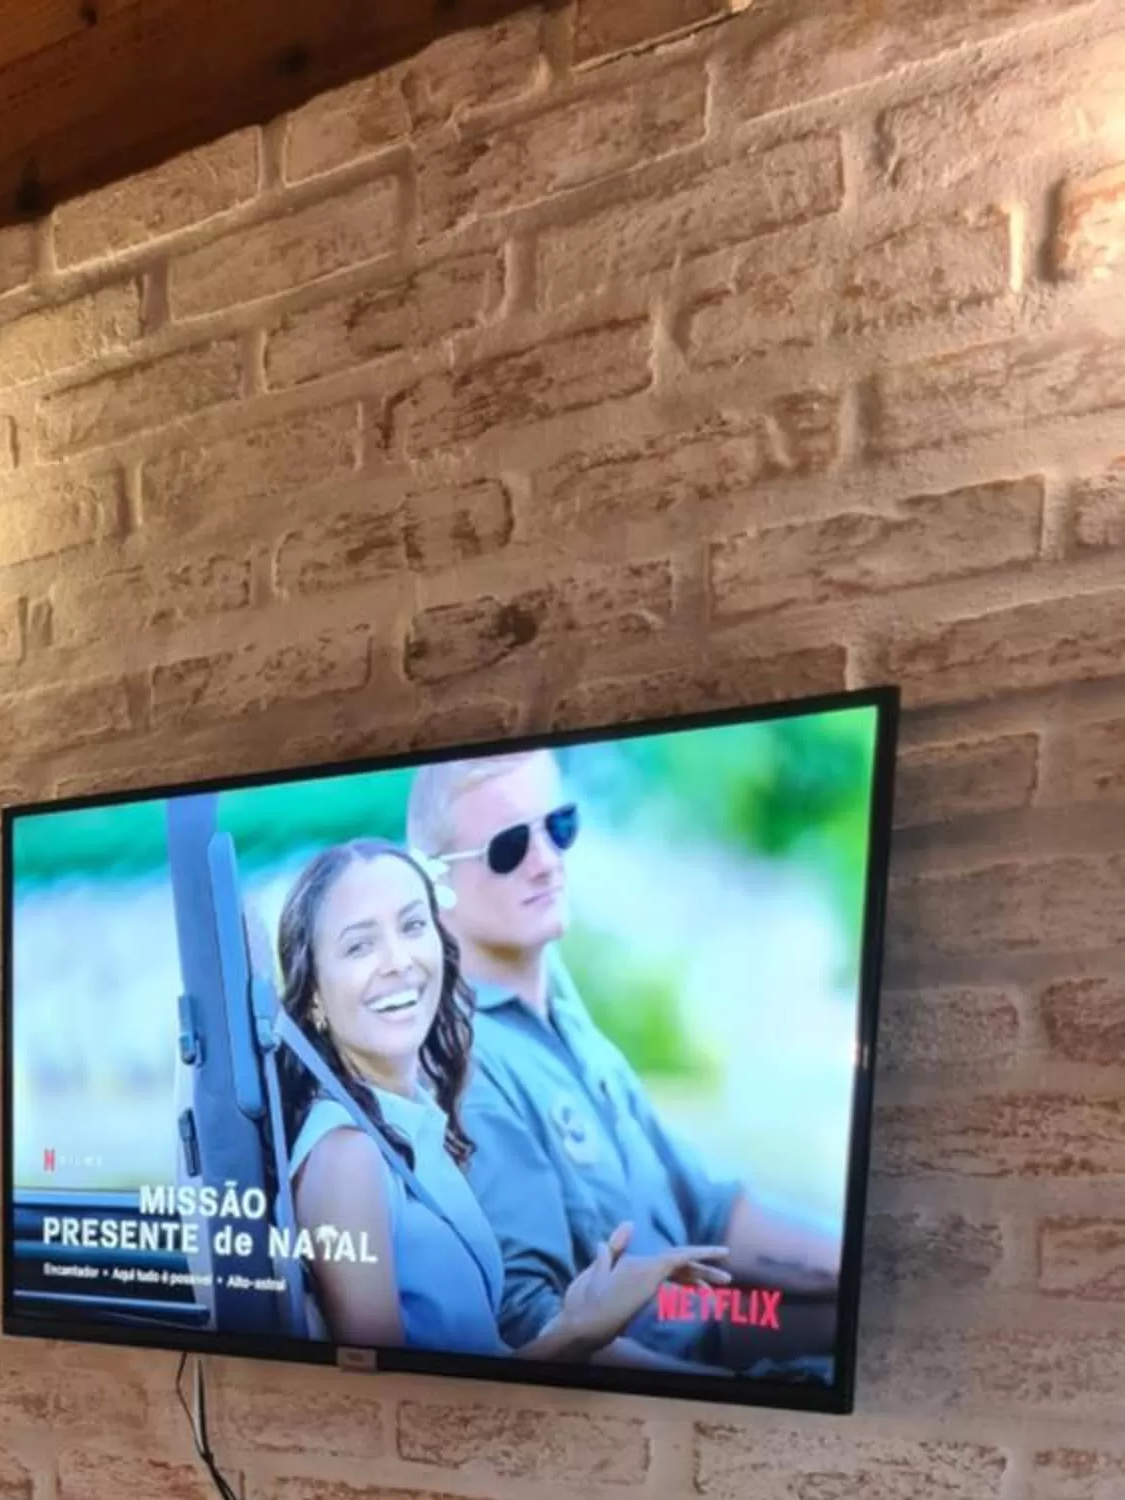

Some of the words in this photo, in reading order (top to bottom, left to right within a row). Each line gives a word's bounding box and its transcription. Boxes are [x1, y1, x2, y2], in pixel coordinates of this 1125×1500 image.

[139, 1180, 267, 1219] MISSÃO
[43, 1216, 200, 1254] PRESENTE
[214, 1224, 254, 1256] de
[268, 1224, 378, 1264] NATAL
[657, 1282, 781, 1329] NETFLIX
